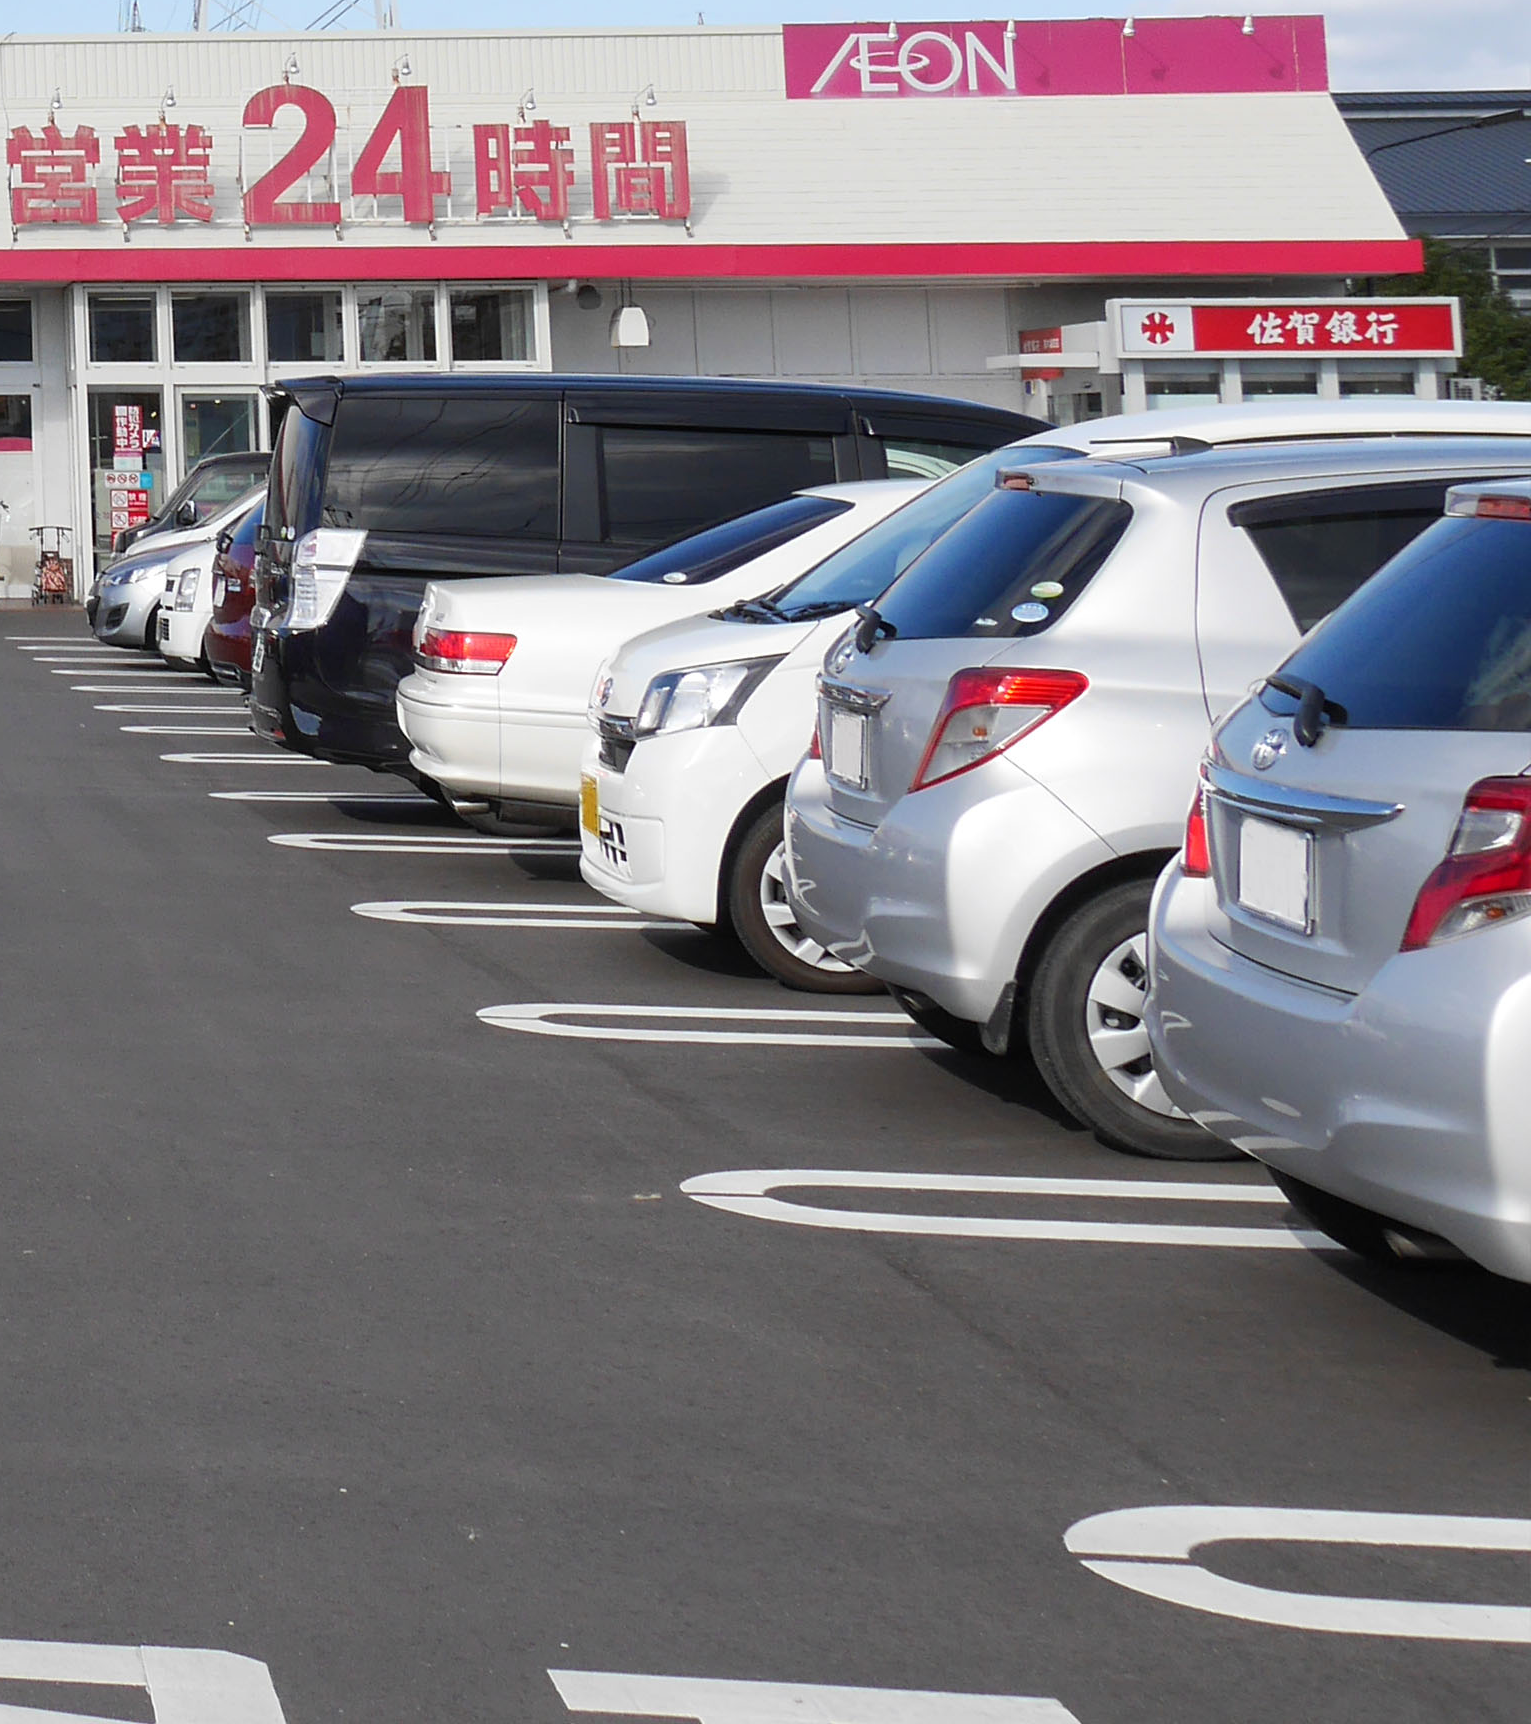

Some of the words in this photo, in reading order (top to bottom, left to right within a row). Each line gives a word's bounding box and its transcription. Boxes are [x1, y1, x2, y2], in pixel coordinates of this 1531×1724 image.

[6, 84, 691, 225] 営業24時間
[1246, 310, 1400, 346] 佐賀銀行
